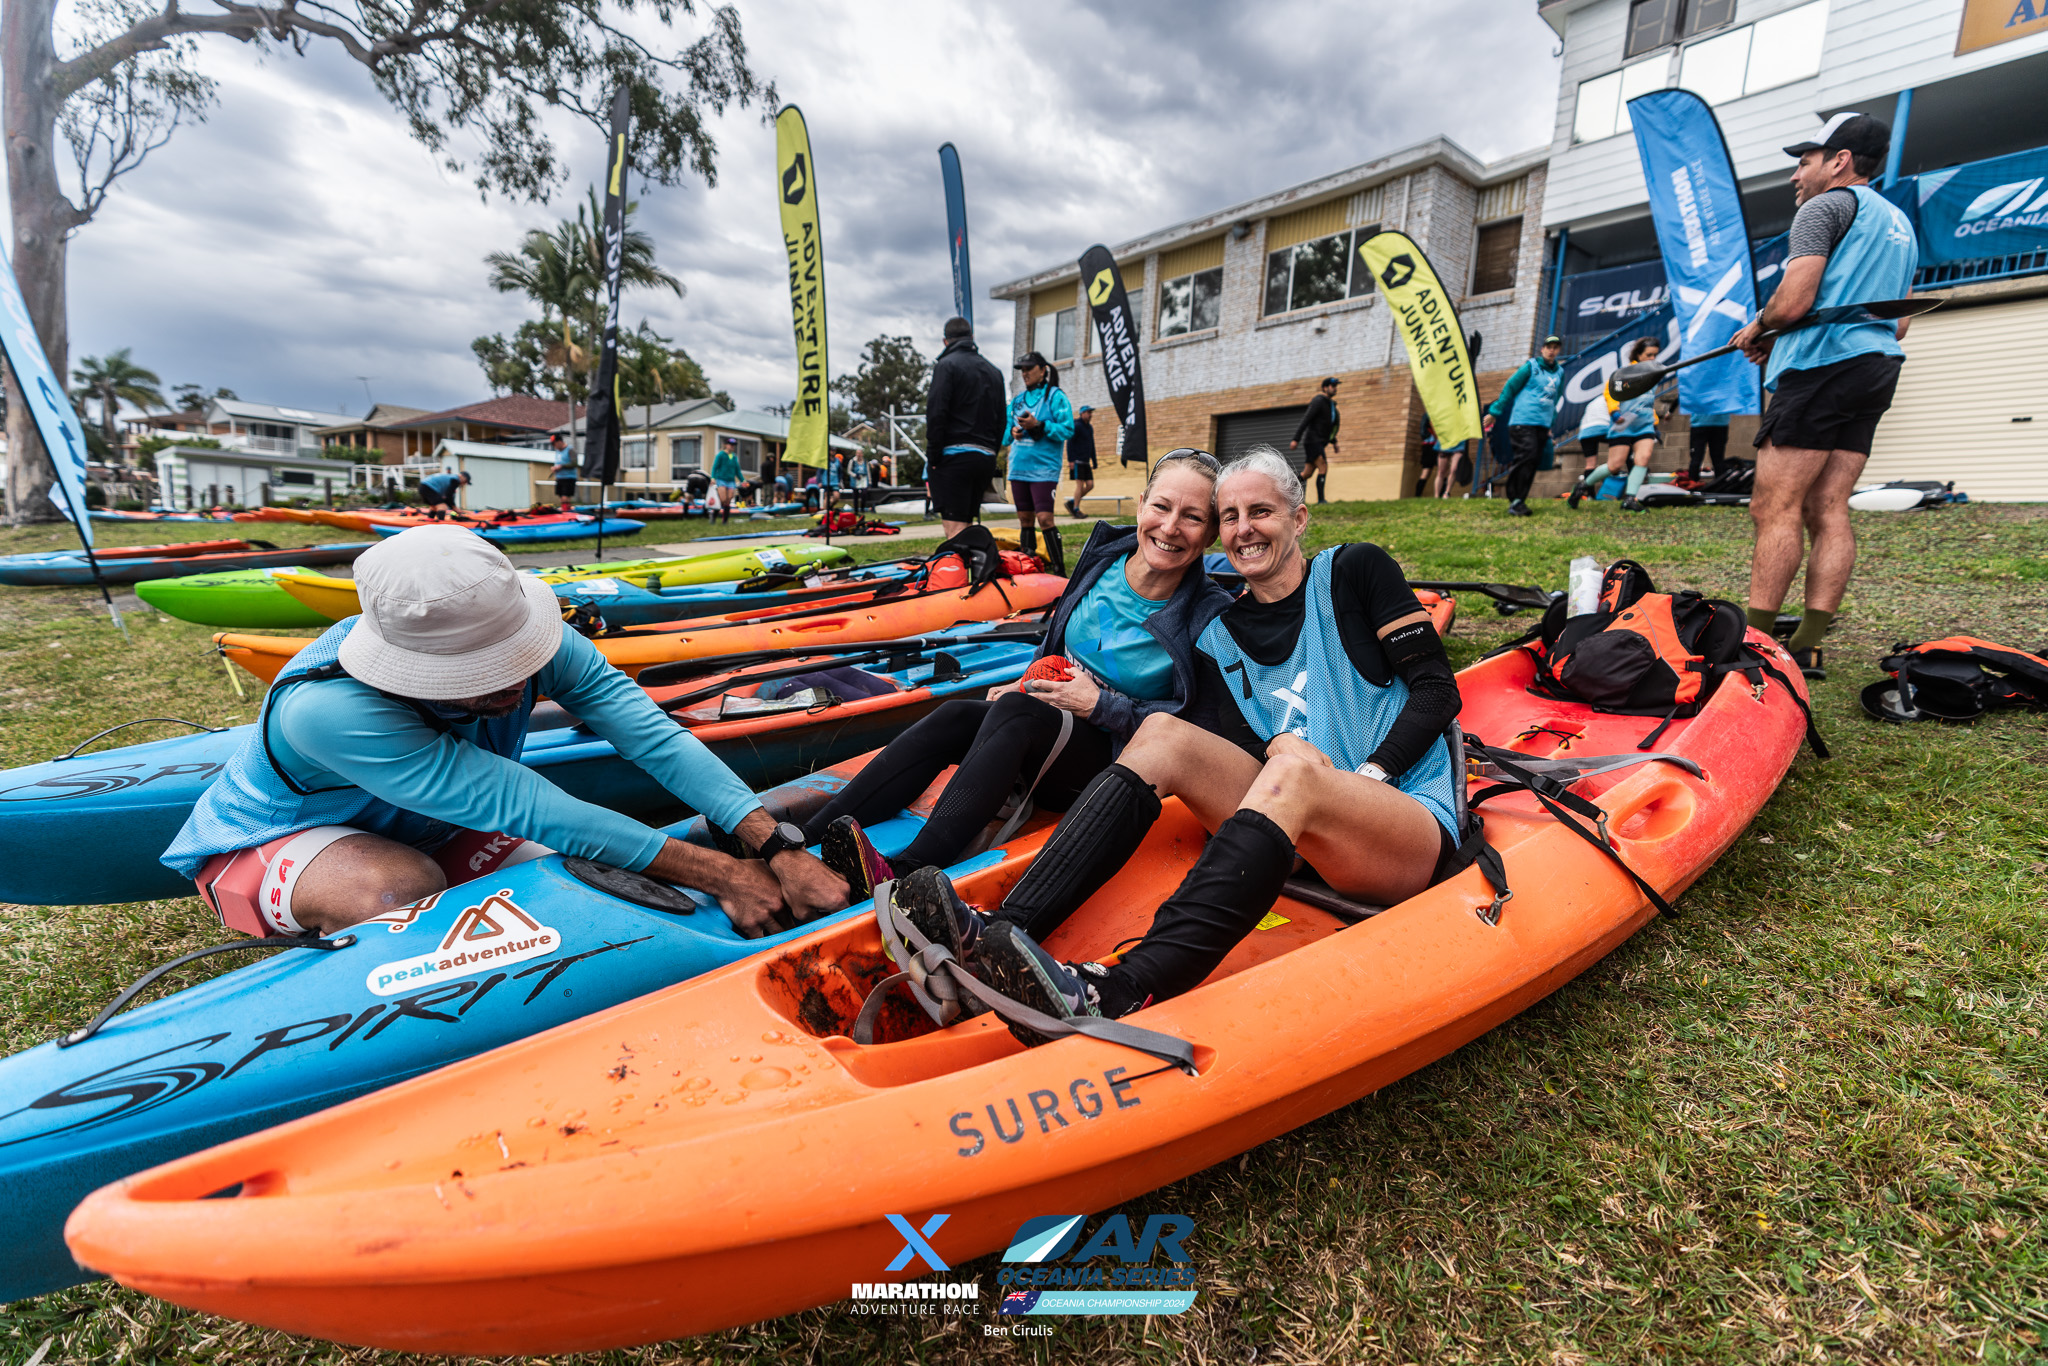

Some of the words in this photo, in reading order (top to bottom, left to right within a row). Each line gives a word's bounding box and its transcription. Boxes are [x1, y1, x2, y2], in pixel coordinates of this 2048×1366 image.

[1671, 165, 1709, 269] MARATHON
[801, 221, 822, 417] ADVENTURE
[1399, 304, 1436, 369] JUNKIE
[1415, 288, 1468, 407] ADVENTURE
[1100, 321, 1128, 393] JUNKIE
[1224, 659, 1253, 700] 7
[469, 833, 519, 872] AK
[378, 934, 552, 989] peakadventure
[949, 1066, 1142, 1158] SURGE
